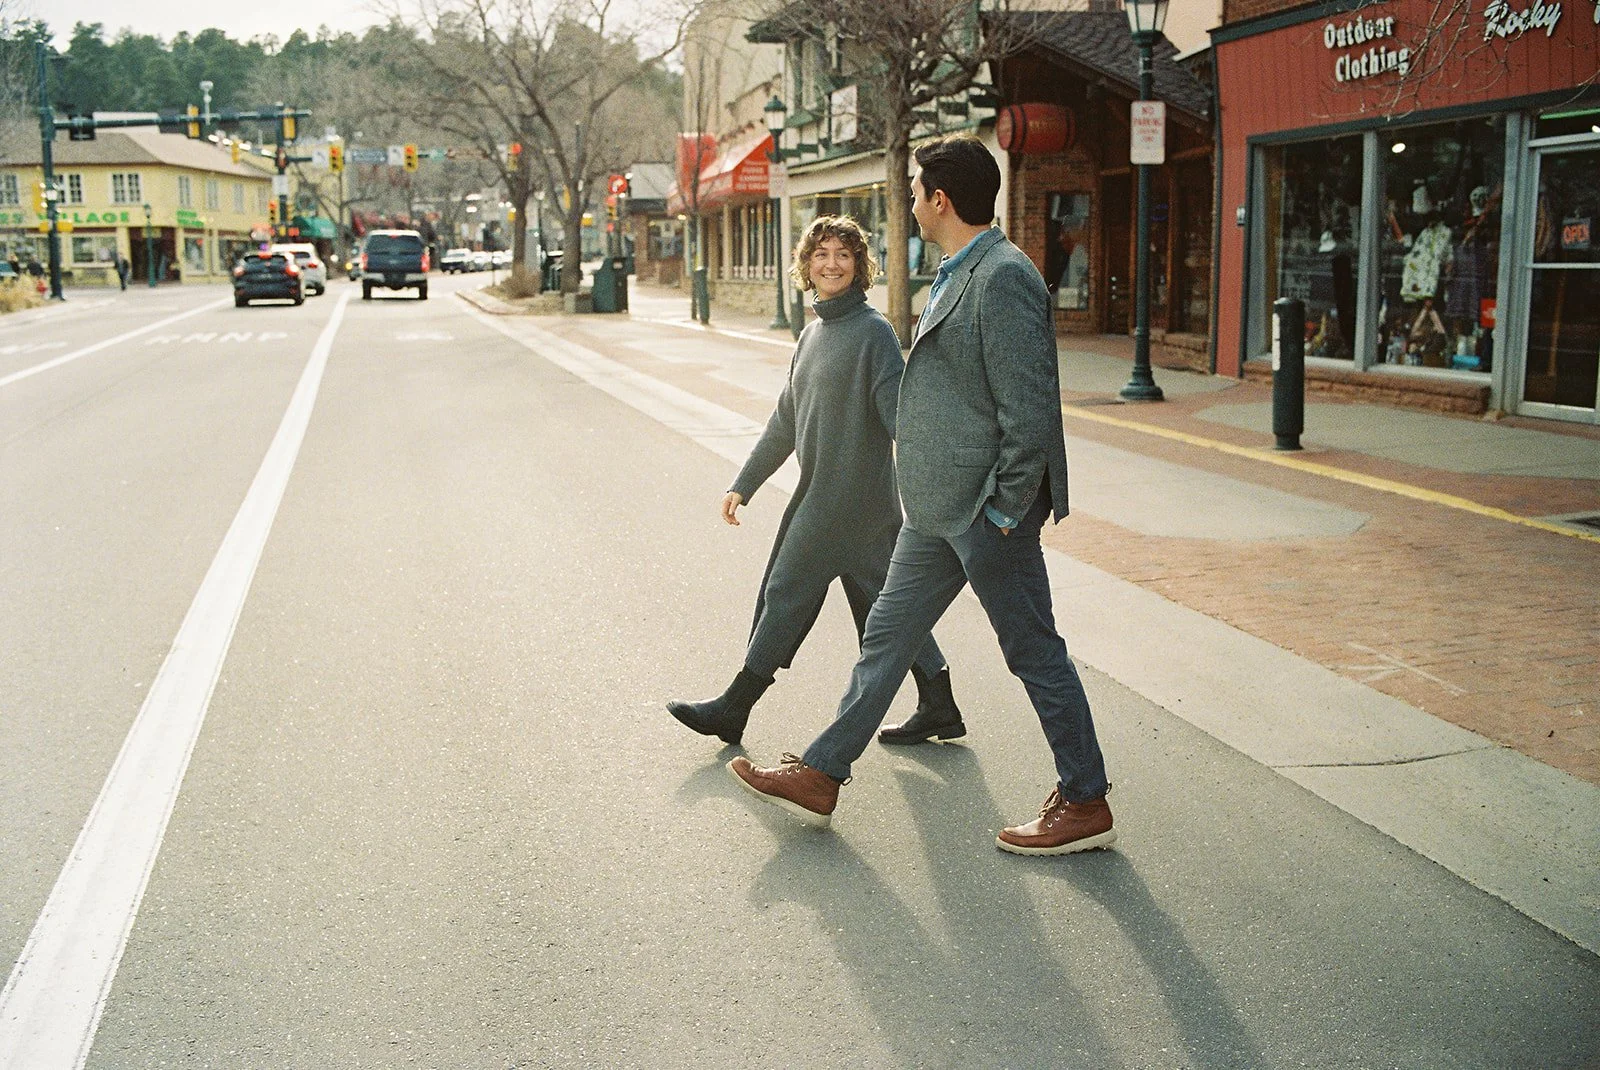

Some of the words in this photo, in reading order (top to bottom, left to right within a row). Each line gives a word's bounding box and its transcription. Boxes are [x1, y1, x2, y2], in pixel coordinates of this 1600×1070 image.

[1323, 15, 1395, 50] Outdoor
[1483, 0, 1562, 42] Rocky
[1334, 45, 1411, 82] Clothing
[37, 210, 130, 224] VLLAGE
[1563, 223, 1591, 245] OPEN
